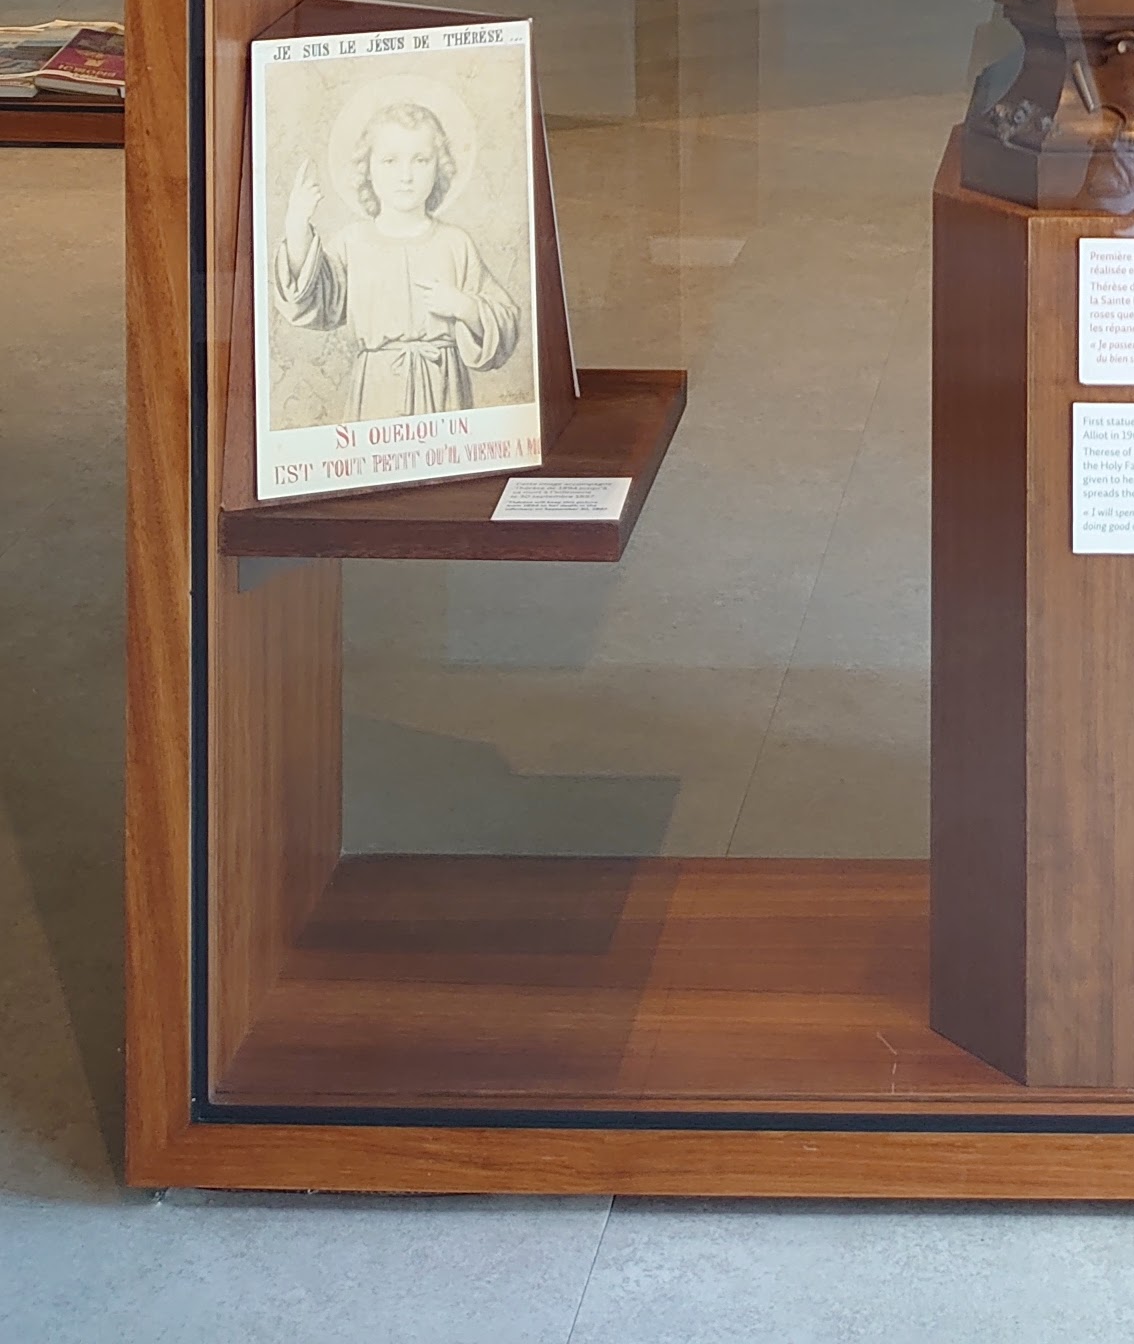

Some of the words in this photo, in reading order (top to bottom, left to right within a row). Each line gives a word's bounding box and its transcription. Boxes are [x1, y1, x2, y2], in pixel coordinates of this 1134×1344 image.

[274, 46, 291, 60] JE
[303, 44, 329, 58] SUIS
[340, 40, 356, 55] LE
[367, 34, 404, 53] JÉSUS
[414, 36, 429, 49] DE
[444, 28, 503, 47] THÉRÈSE
[1090, 251, 1131, 261] Première
[1091, 265, 1126, 274] réalisée
[1091, 282, 1127, 291] Thérèse
[1090, 296, 1098, 304] la
[1101, 296, 1130, 305] Sainte
[1117, 312, 1134, 320] que
[1083, 417, 1103, 426] First
[1083, 430, 1108, 440] Alliot
[1084, 447, 1120, 456] Therese
[1123, 447, 1131, 456] of
[274, 464, 313, 485] EST
[323, 457, 366, 479] TOUT
[372, 450, 421, 473] PETIT
[426, 446, 460, 467] QU'IL
[465, 441, 511, 463] VIENNE
[515, 439, 523, 456] A
[1083, 461, 1098, 470] the
[1101, 461, 1122, 472] Holy
[1083, 477, 1108, 486] given
[1111, 476, 1120, 484] to
